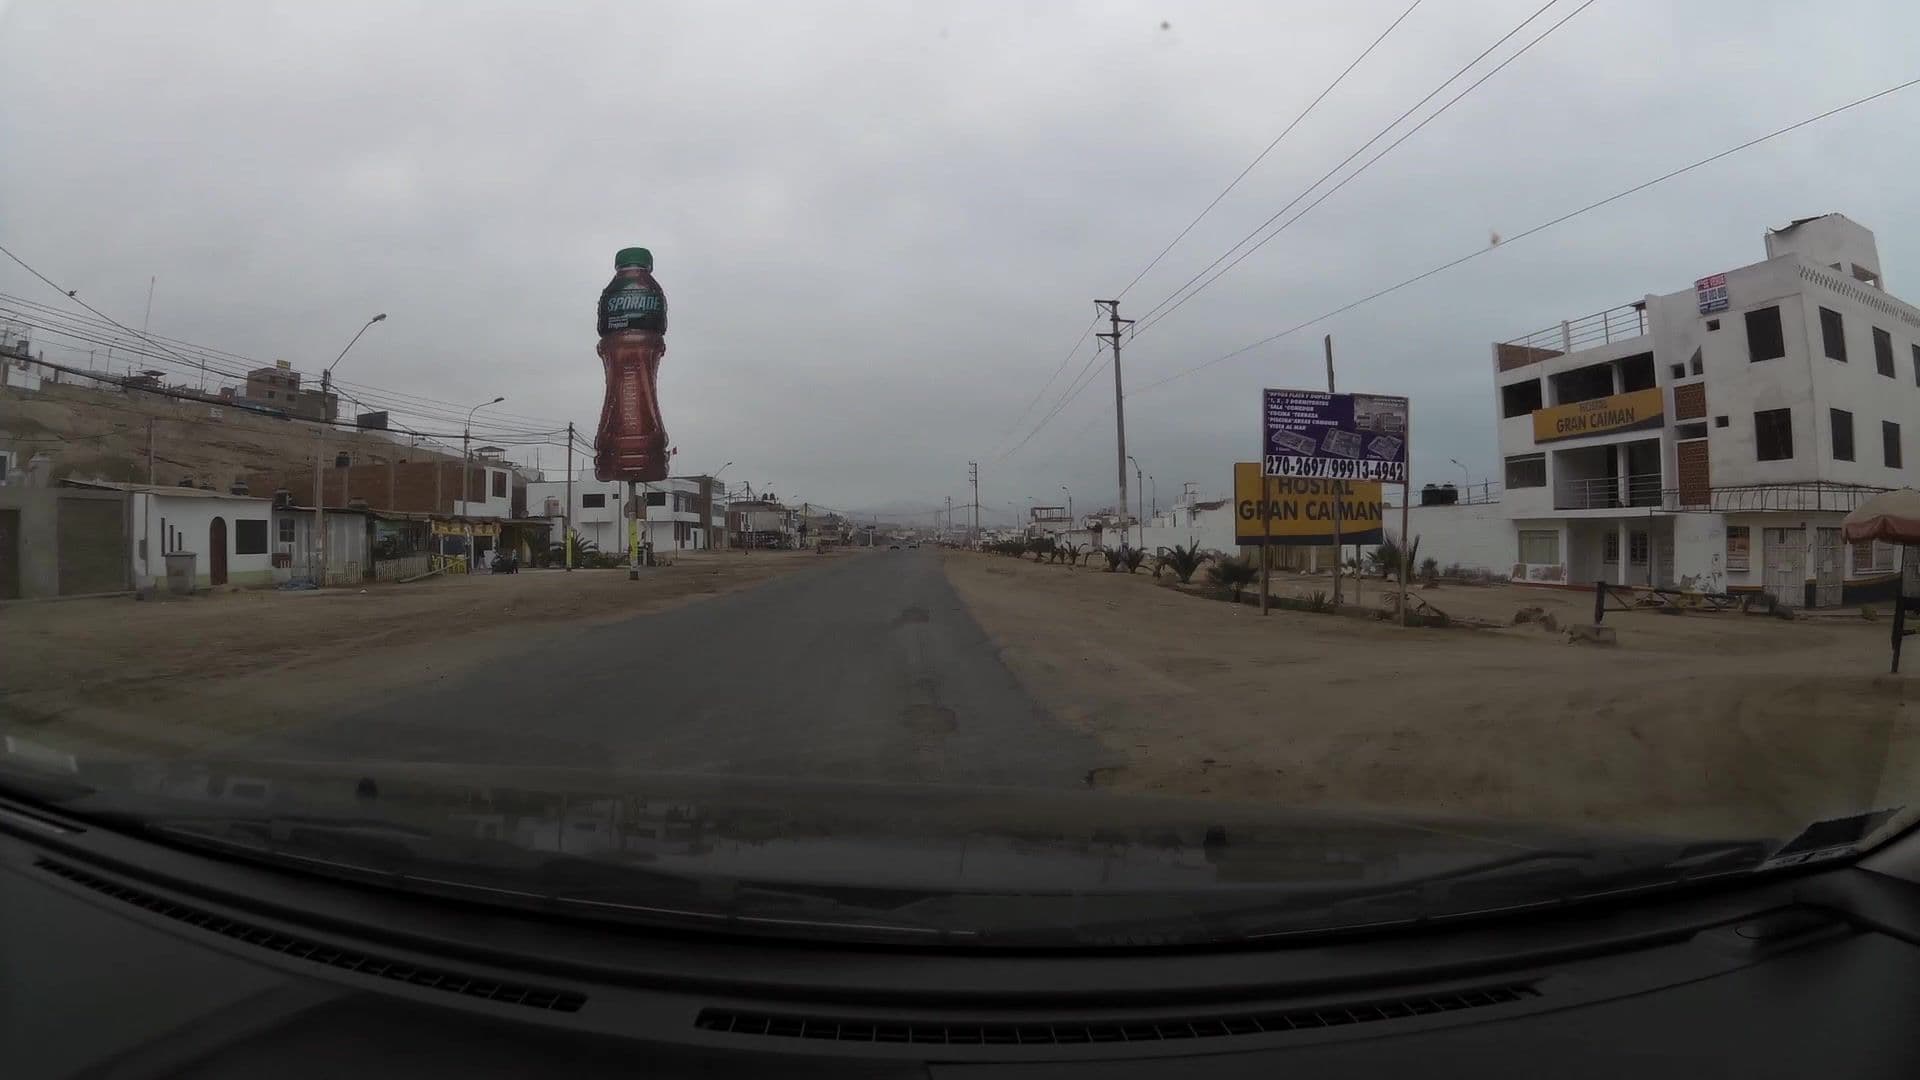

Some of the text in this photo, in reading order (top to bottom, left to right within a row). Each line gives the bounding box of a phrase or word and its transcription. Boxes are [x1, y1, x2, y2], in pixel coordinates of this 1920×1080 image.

[607, 295, 659, 312] SPORADE
[1556, 407, 1635, 433] GRAN CAIMAN
[1278, 479, 1354, 496] HOSTAL
[1239, 500, 1382, 521] GRAN CAIMAN
